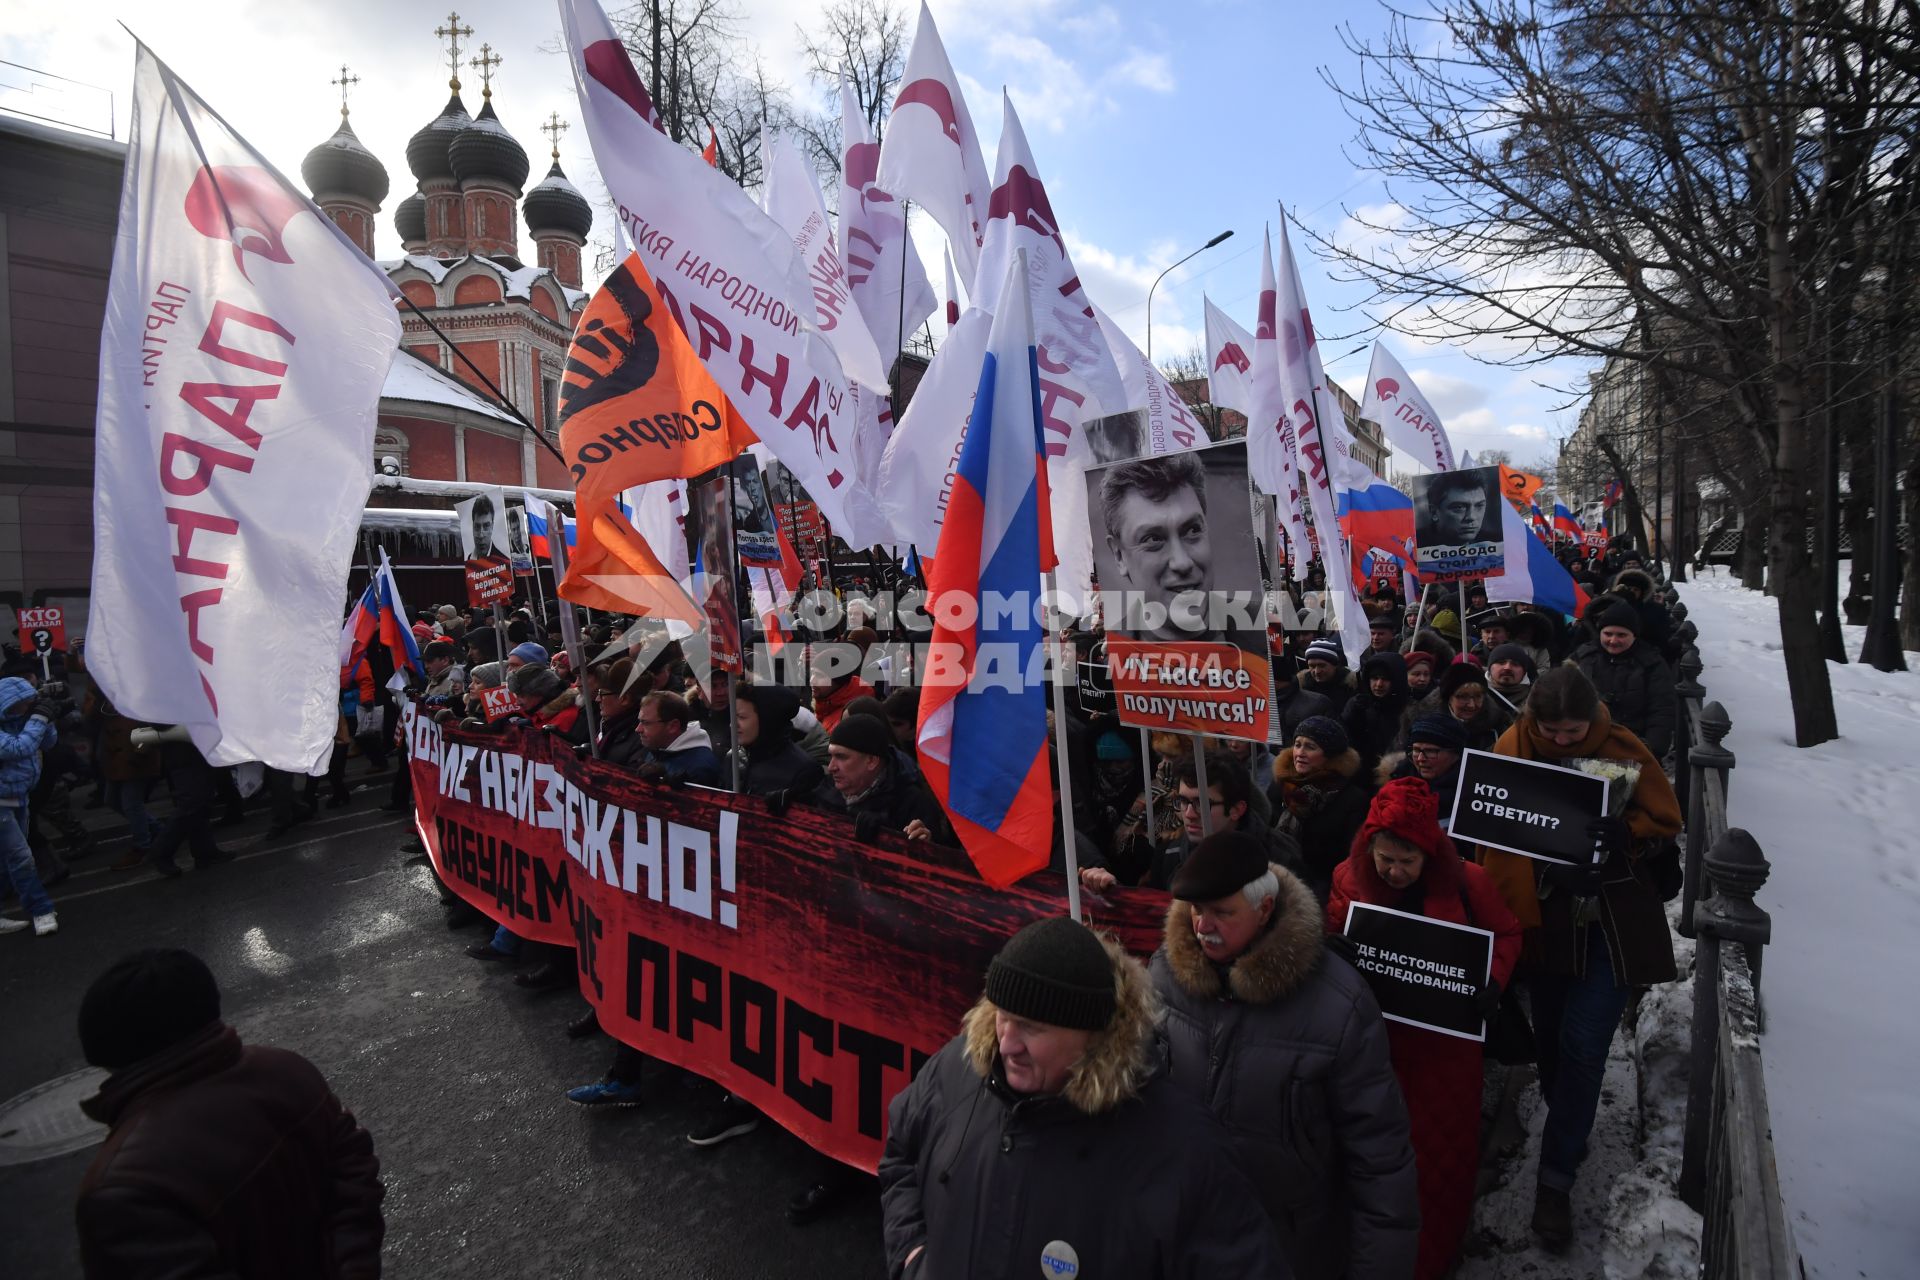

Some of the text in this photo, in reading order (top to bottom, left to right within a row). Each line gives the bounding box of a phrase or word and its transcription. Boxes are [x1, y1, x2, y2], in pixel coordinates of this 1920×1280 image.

[618, 204, 675, 261] РТИЯ
[1590, 547, 1598, 557] ?
[1373, 563, 1397, 576] КТО
[1438, 557, 1477, 569] стоит
[474, 577, 500, 590] верить
[21, 608, 61, 623] КТО
[22, 620, 62, 628] ЗАКАЗАЛ
[35, 630, 49, 647] ?
[1158, 667, 1201, 687] нас
[1207, 668, 1251, 690] все
[484, 687, 518, 709] КТ
[488, 703, 521, 717] ЗАКАЗ
[402, 702, 479, 803] ВОЗИЕ
[1474, 782, 1509, 800] КТО
[1470, 799, 1561, 830] ОТВЕТИТ?
[1379, 949, 1466, 980] НАСТОЯЩЕЕ
[1354, 958, 1476, 997] АССЛЕДОВАНИЕ?
[626, 931, 932, 1141] ПРОСТ
